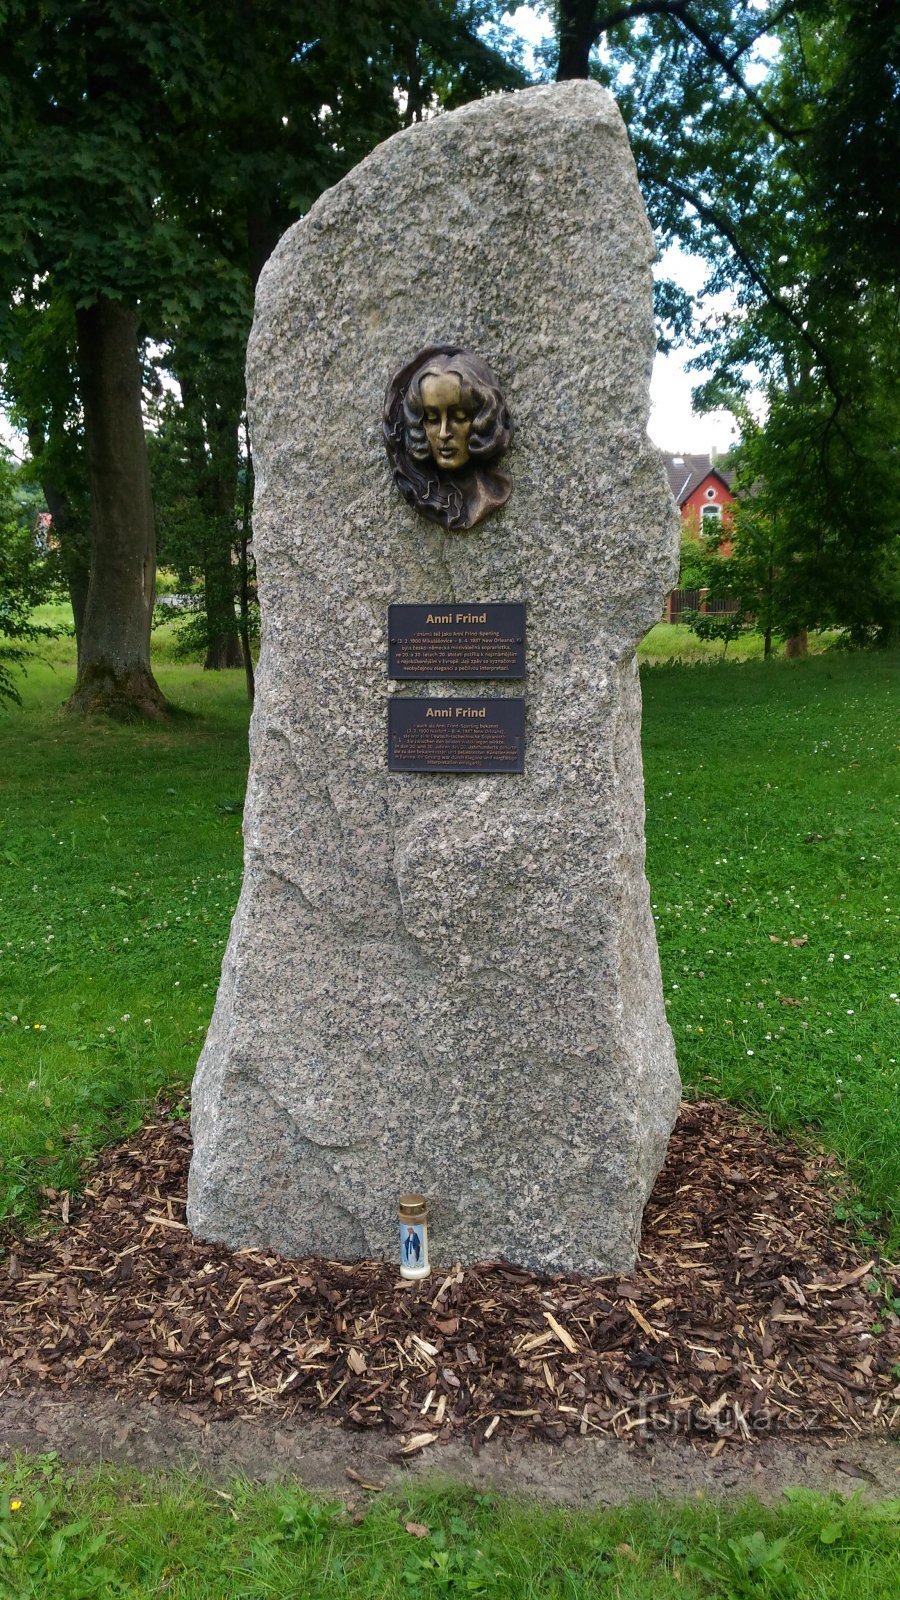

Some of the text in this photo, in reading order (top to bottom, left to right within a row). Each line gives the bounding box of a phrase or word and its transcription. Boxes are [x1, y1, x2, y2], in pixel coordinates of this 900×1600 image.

[426, 614, 487, 624] Anni Frind
[426, 707, 486, 718] Anni Frind
